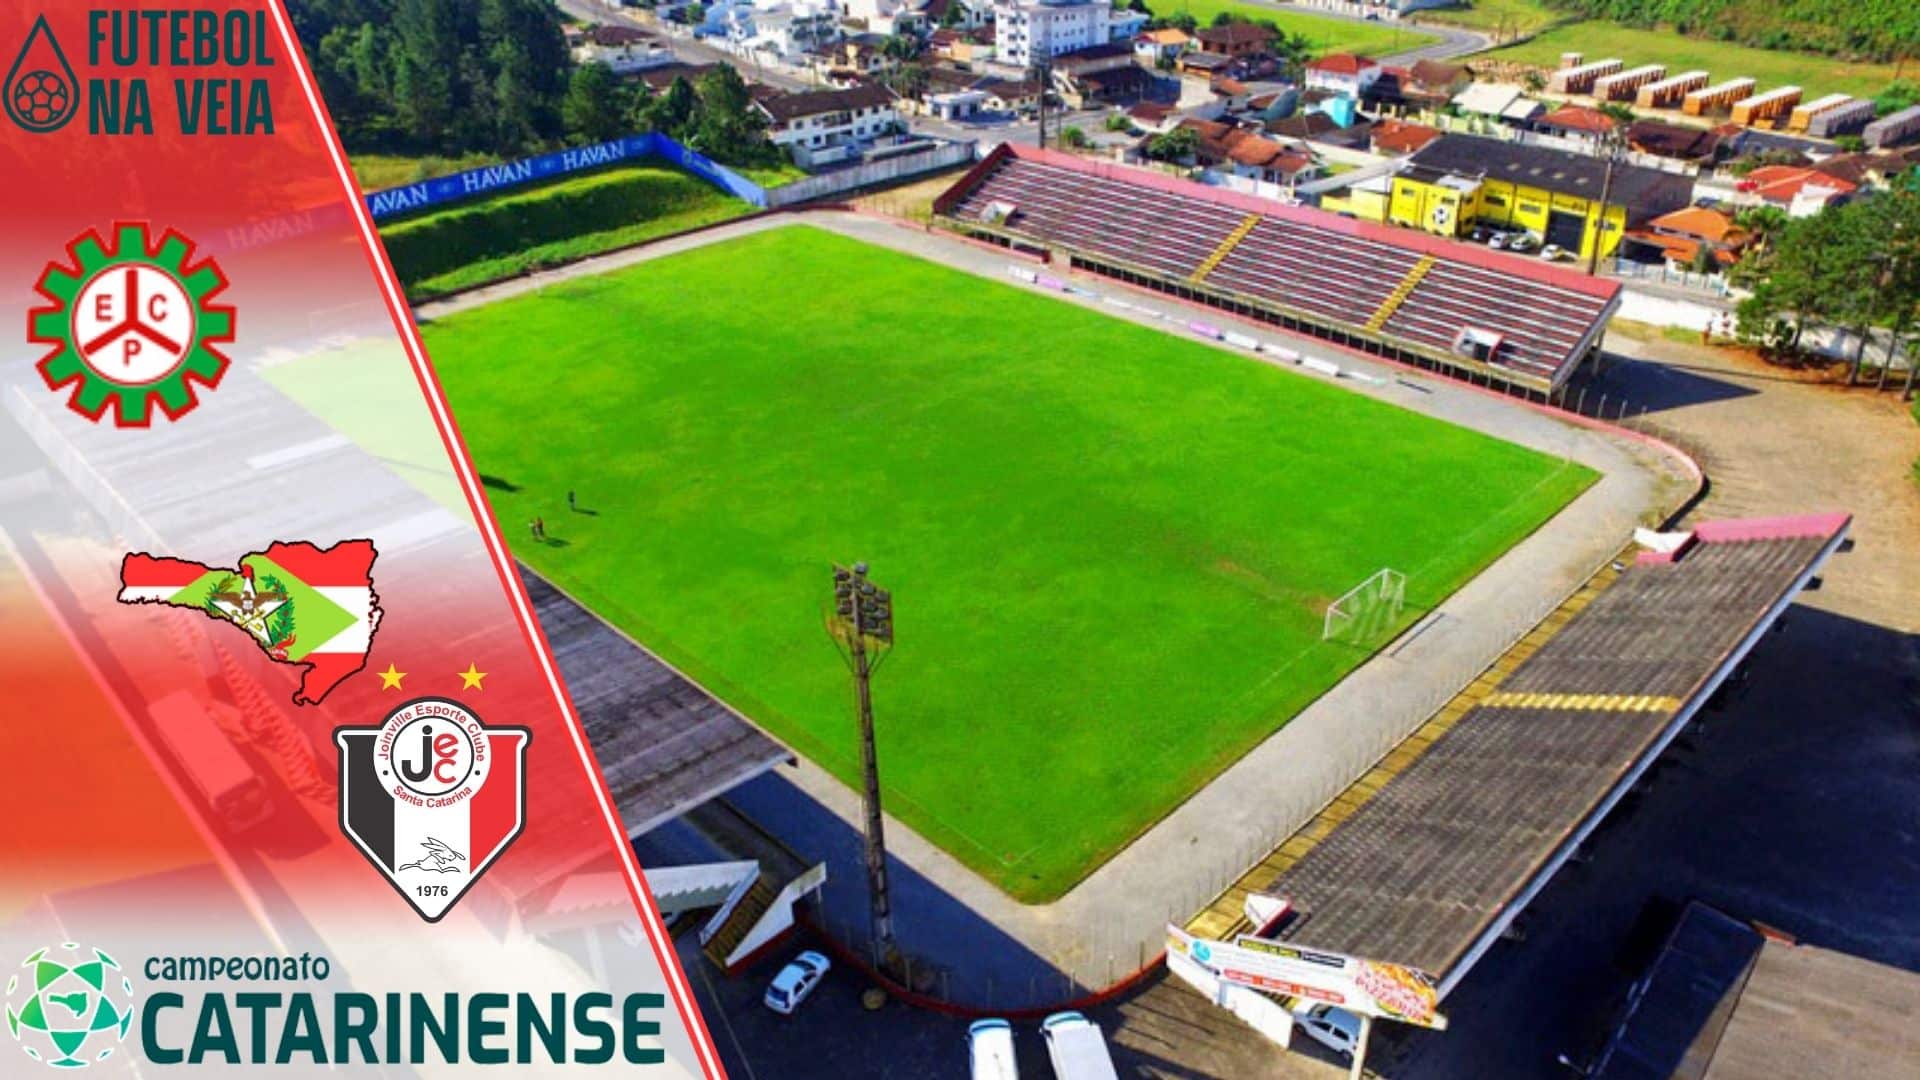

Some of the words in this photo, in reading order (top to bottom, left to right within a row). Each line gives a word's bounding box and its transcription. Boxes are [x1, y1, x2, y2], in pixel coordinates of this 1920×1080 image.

[563, 141, 625, 171] HAVAN
[463, 158, 531, 192] HAVAN
[372, 183, 428, 215] AVAN
[225, 211, 313, 249] HAVAN
